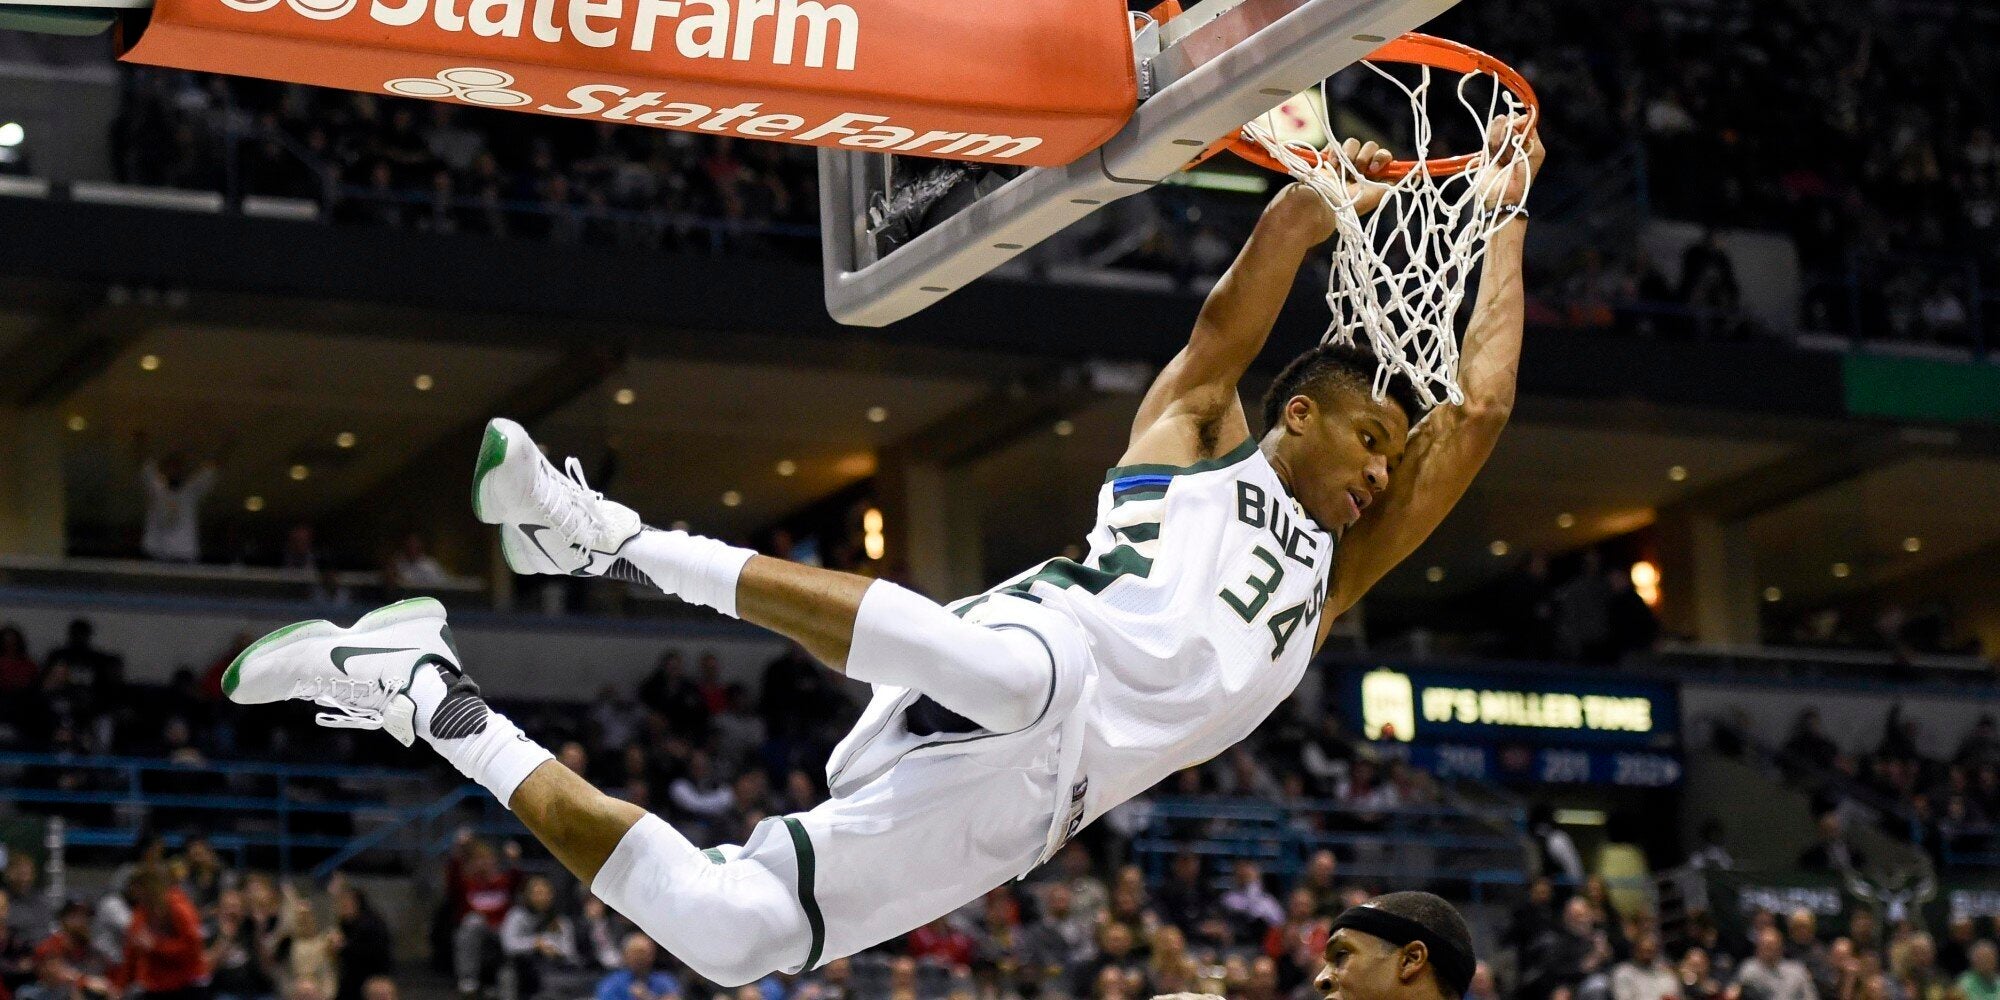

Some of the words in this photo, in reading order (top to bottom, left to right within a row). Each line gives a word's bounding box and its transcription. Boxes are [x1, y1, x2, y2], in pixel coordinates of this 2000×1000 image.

[370, 0, 859, 71] ateFarm
[1236, 479, 1324, 627] BUCS
[1218, 544, 1306, 662] 34
[1479, 690, 1582, 728] MILLER
[1582, 695, 1652, 732] TIME
